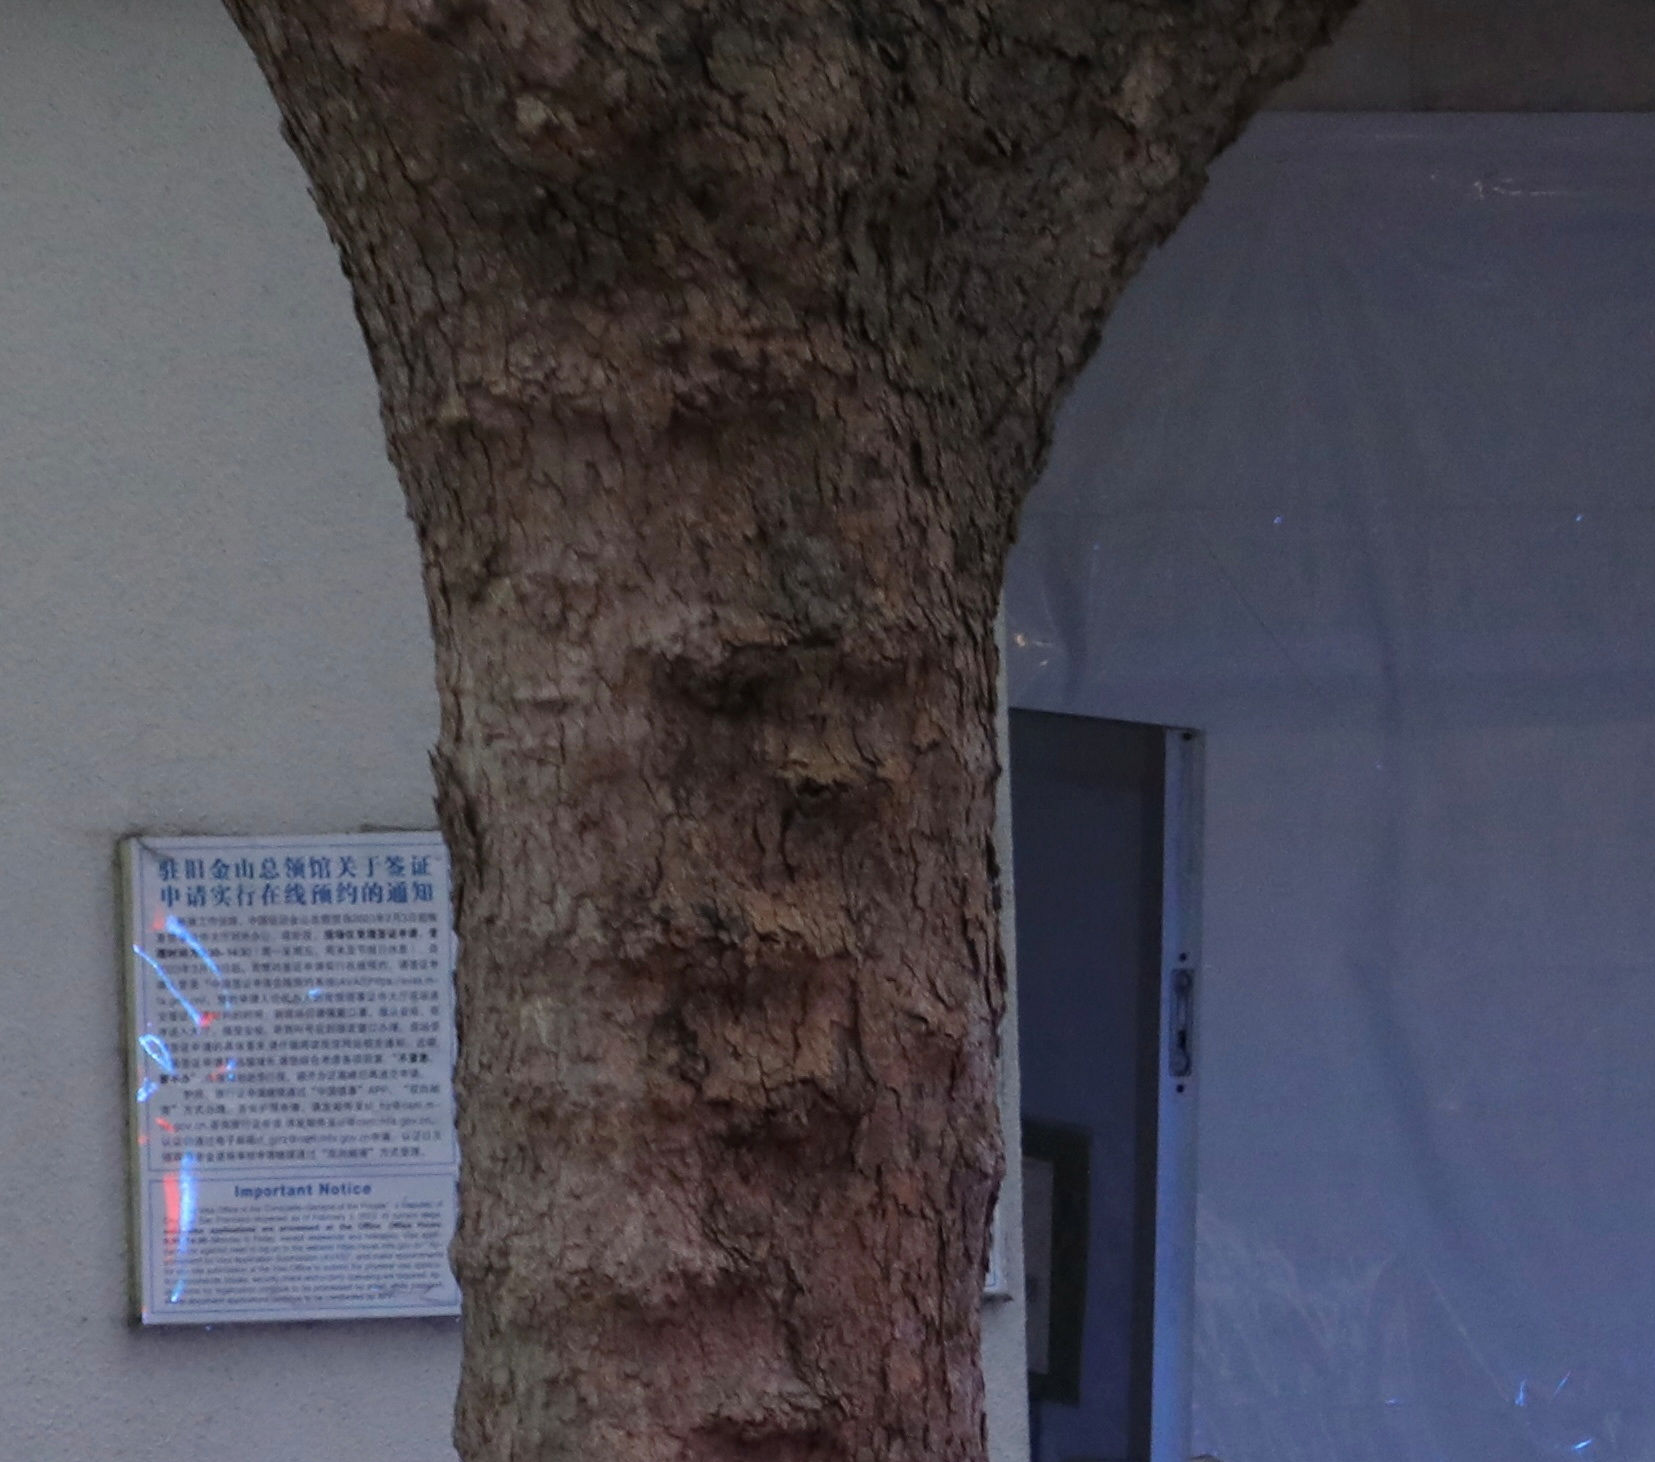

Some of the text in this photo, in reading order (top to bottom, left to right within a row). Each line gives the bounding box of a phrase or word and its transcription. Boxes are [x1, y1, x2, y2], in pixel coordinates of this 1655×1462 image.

[158, 854, 433, 883] 驻旧金山总领馆关于签证
[159, 880, 434, 908] 申请实行在线预约的通知
[234, 1183, 372, 1200] Important Notice
